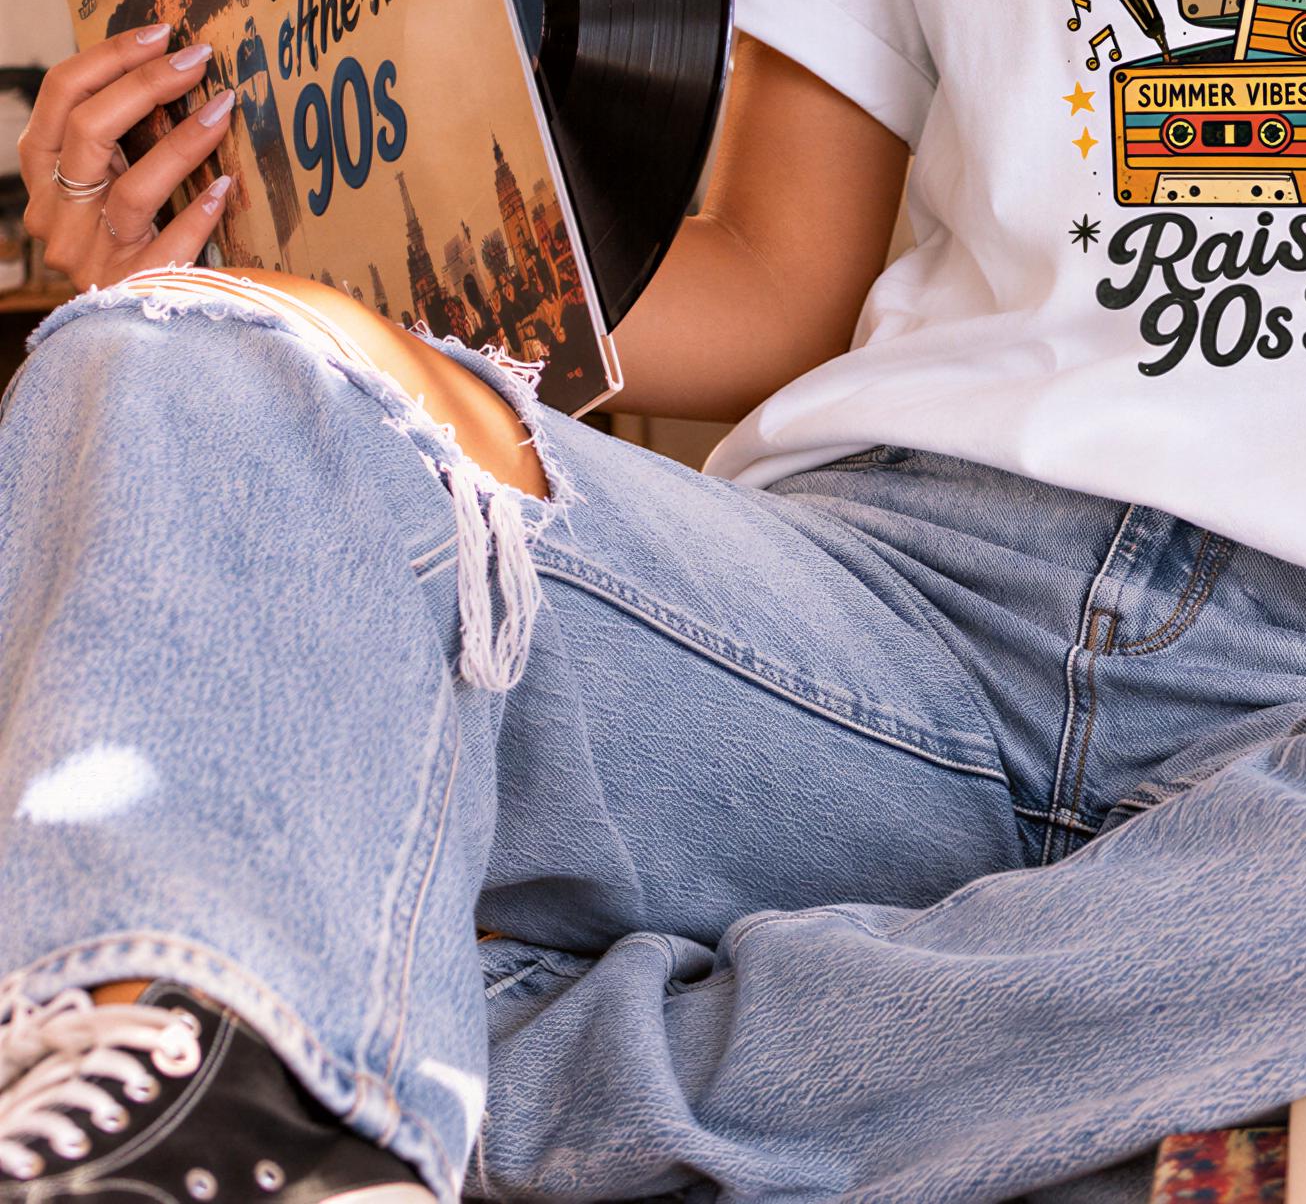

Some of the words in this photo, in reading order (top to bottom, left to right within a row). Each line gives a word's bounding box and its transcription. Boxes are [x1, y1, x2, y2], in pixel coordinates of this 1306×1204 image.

[293, 55, 409, 217] 90s
[1137, 82, 1237, 108] SUMMER
[1137, 283, 1294, 378] 90s
